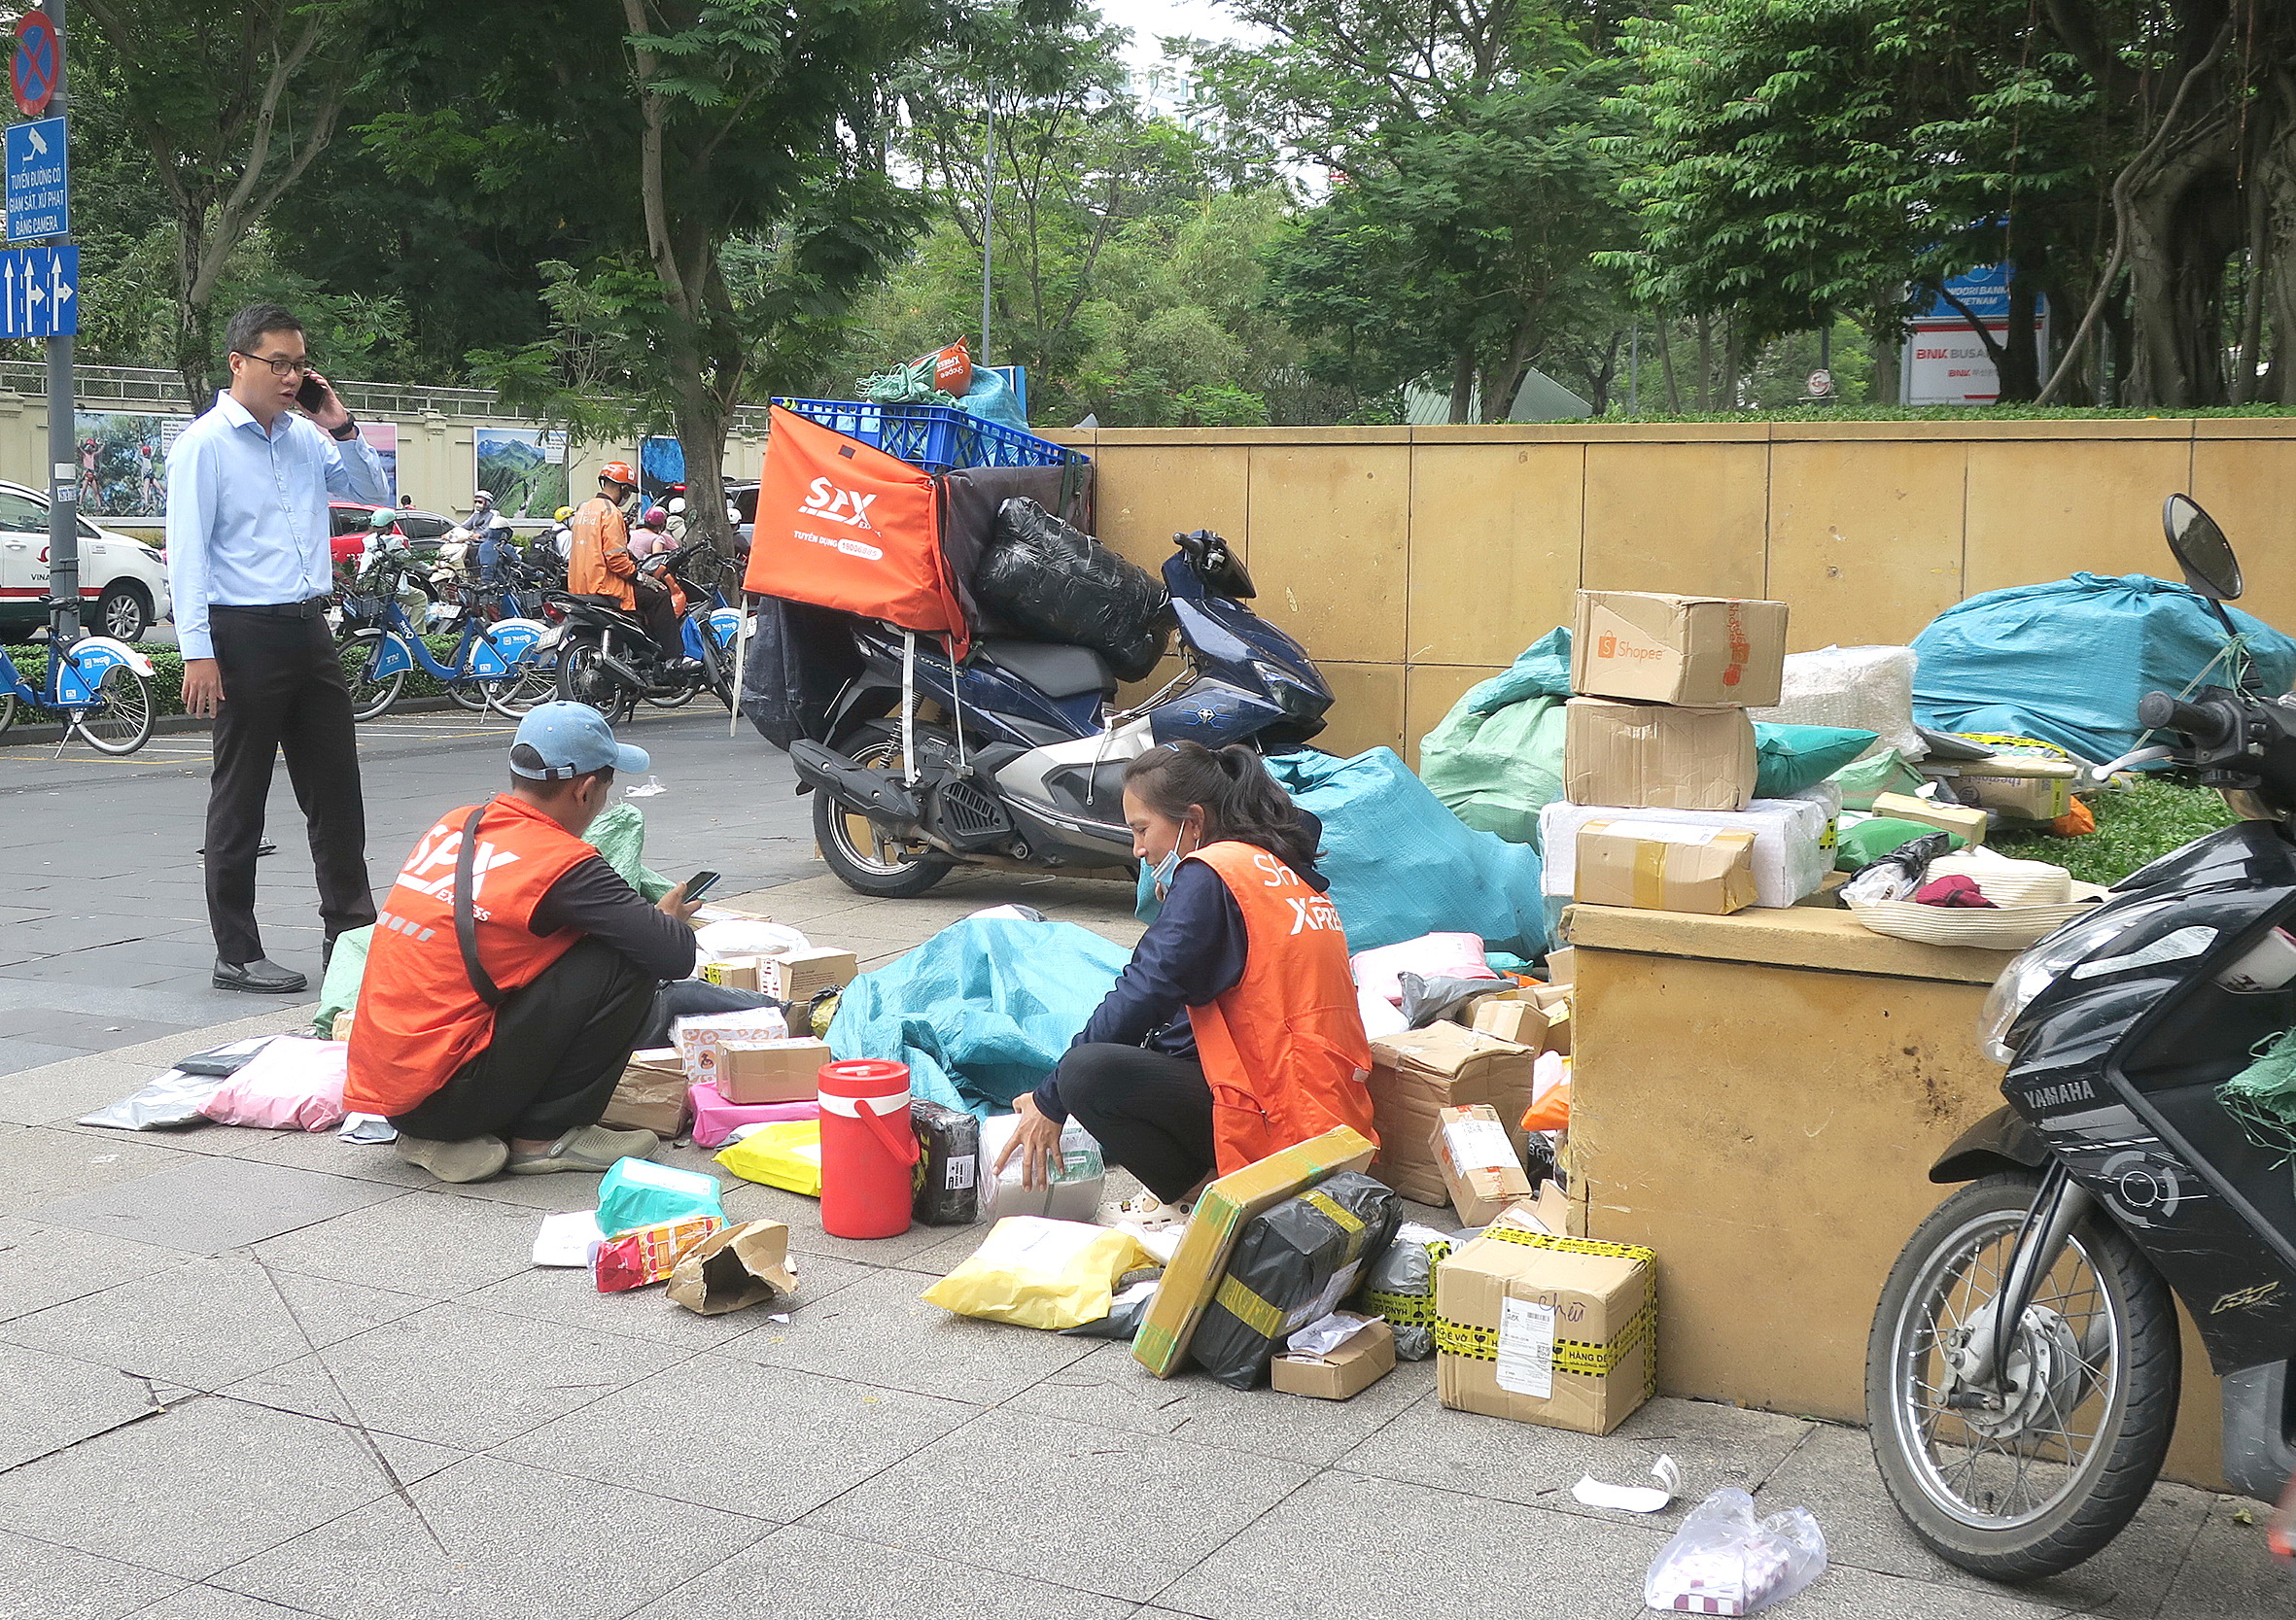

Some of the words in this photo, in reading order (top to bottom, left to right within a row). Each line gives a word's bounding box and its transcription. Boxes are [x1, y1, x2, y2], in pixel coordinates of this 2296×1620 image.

[11, 167, 30, 190] TUYẾN
[30, 165, 52, 187] ĐƯỜNG
[52, 162, 61, 183] CÓ
[9, 192, 24, 213] GIÁM
[38, 187, 47, 209] XỬ
[47, 190, 64, 210] PHẠT
[16, 213, 32, 236] BẰNG
[33, 215, 58, 233] CAMERA
[1916, 349, 1948, 360] BNK
[1950, 349, 1988, 359] BUSA
[1618, 640, 1663, 663] Shopee
[435, 888, 491, 922] EXSS
[1285, 896, 1344, 935] XPRE
[2024, 1080, 2096, 1109] YAMAHA
